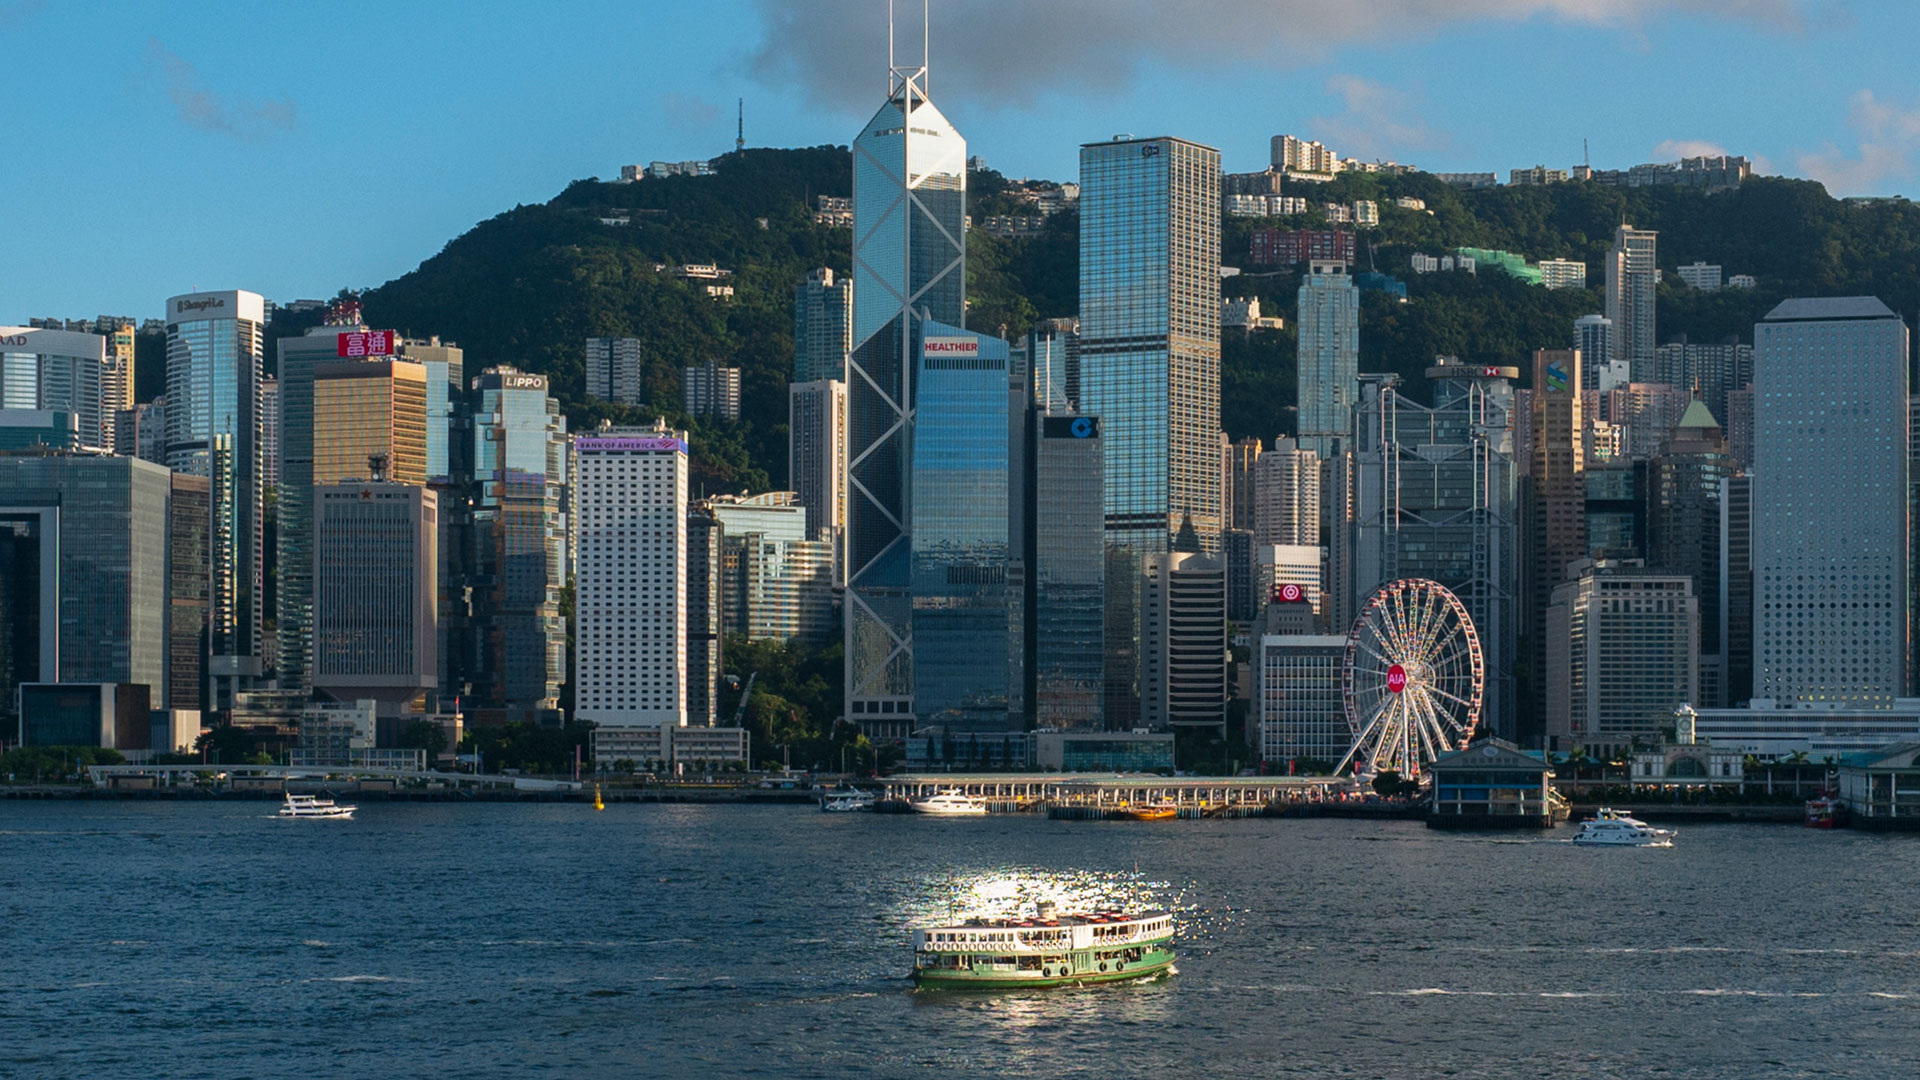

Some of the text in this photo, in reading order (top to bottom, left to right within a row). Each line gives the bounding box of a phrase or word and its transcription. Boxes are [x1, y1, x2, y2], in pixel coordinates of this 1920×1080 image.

[347, 331, 386, 356] 富通
[924, 342, 978, 352] HEALTHIER
[1451, 367, 1482, 377] HSBC
[506, 377, 542, 388] LIPPO
[1388, 673, 1405, 685] AIA
